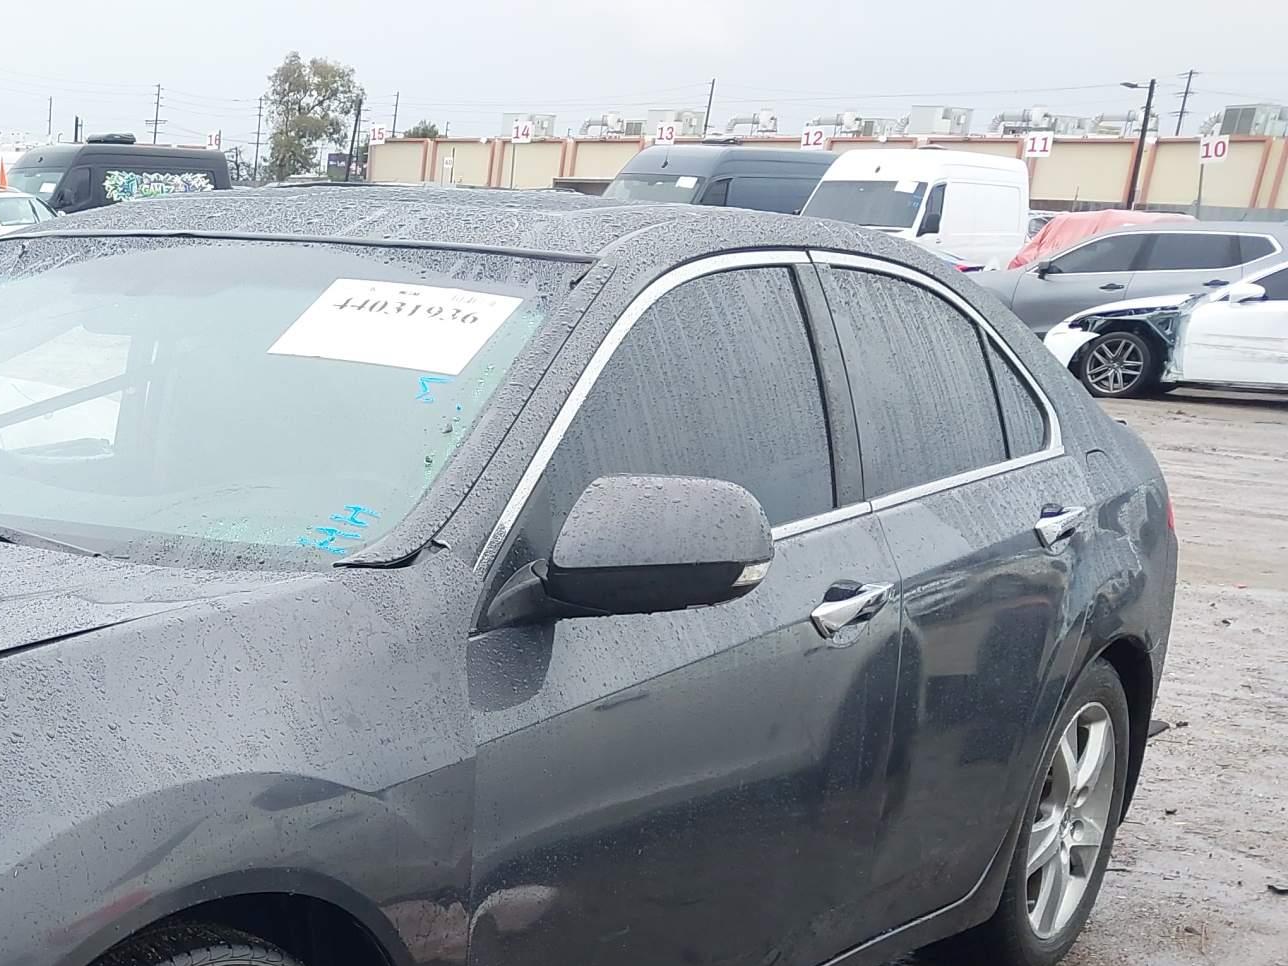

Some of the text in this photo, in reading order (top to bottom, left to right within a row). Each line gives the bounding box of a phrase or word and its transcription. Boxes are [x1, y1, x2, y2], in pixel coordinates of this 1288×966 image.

[371, 127, 384, 141] 15
[512, 125, 530, 139] 14
[657, 126, 674, 141] 13
[803, 131, 823, 146] 12
[1028, 136, 1050, 153] 11
[1201, 140, 1227, 159] 10
